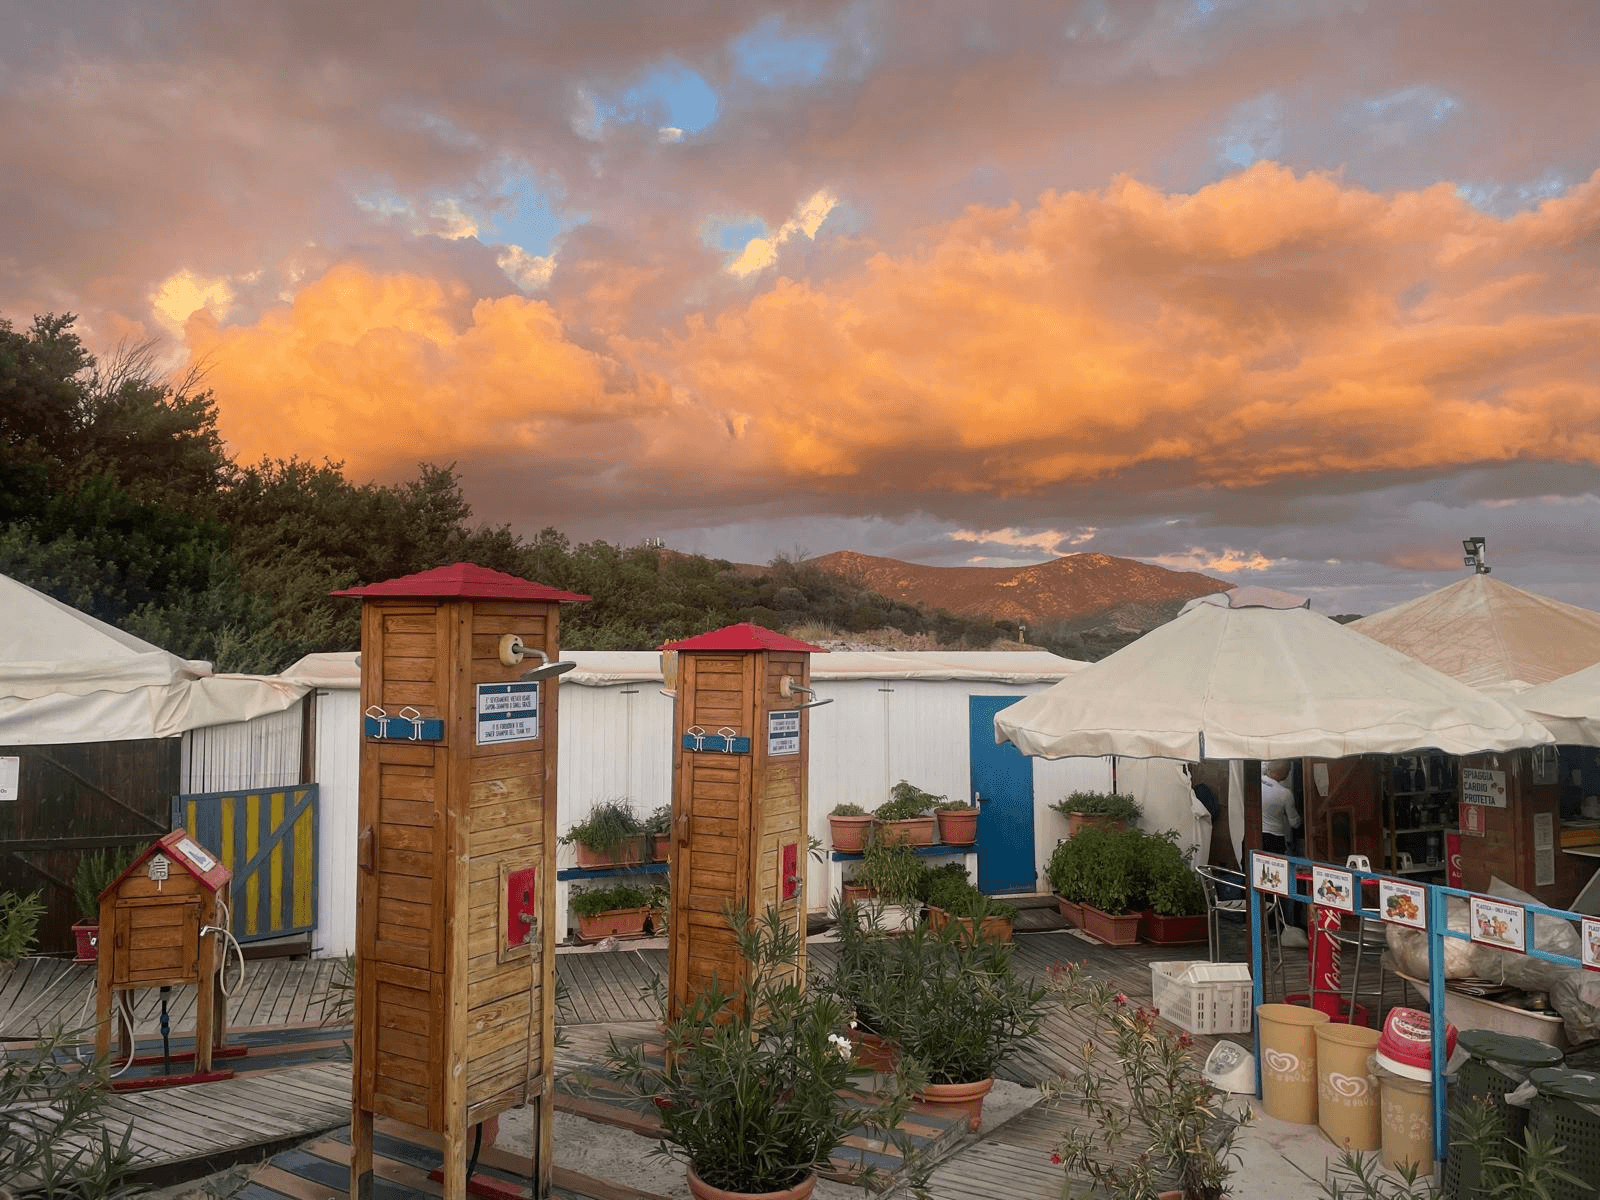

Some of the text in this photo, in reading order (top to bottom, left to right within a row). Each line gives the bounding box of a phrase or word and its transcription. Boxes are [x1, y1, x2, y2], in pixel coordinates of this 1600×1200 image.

[1463, 770, 1494, 781] SPIAGGIA
[1464, 782, 1488, 793] CARDIO
[1464, 793, 1496, 805] PROTETTA
[1476, 903, 1491, 911] PLASTICA
[1504, 907, 1519, 917] PLASTIC
